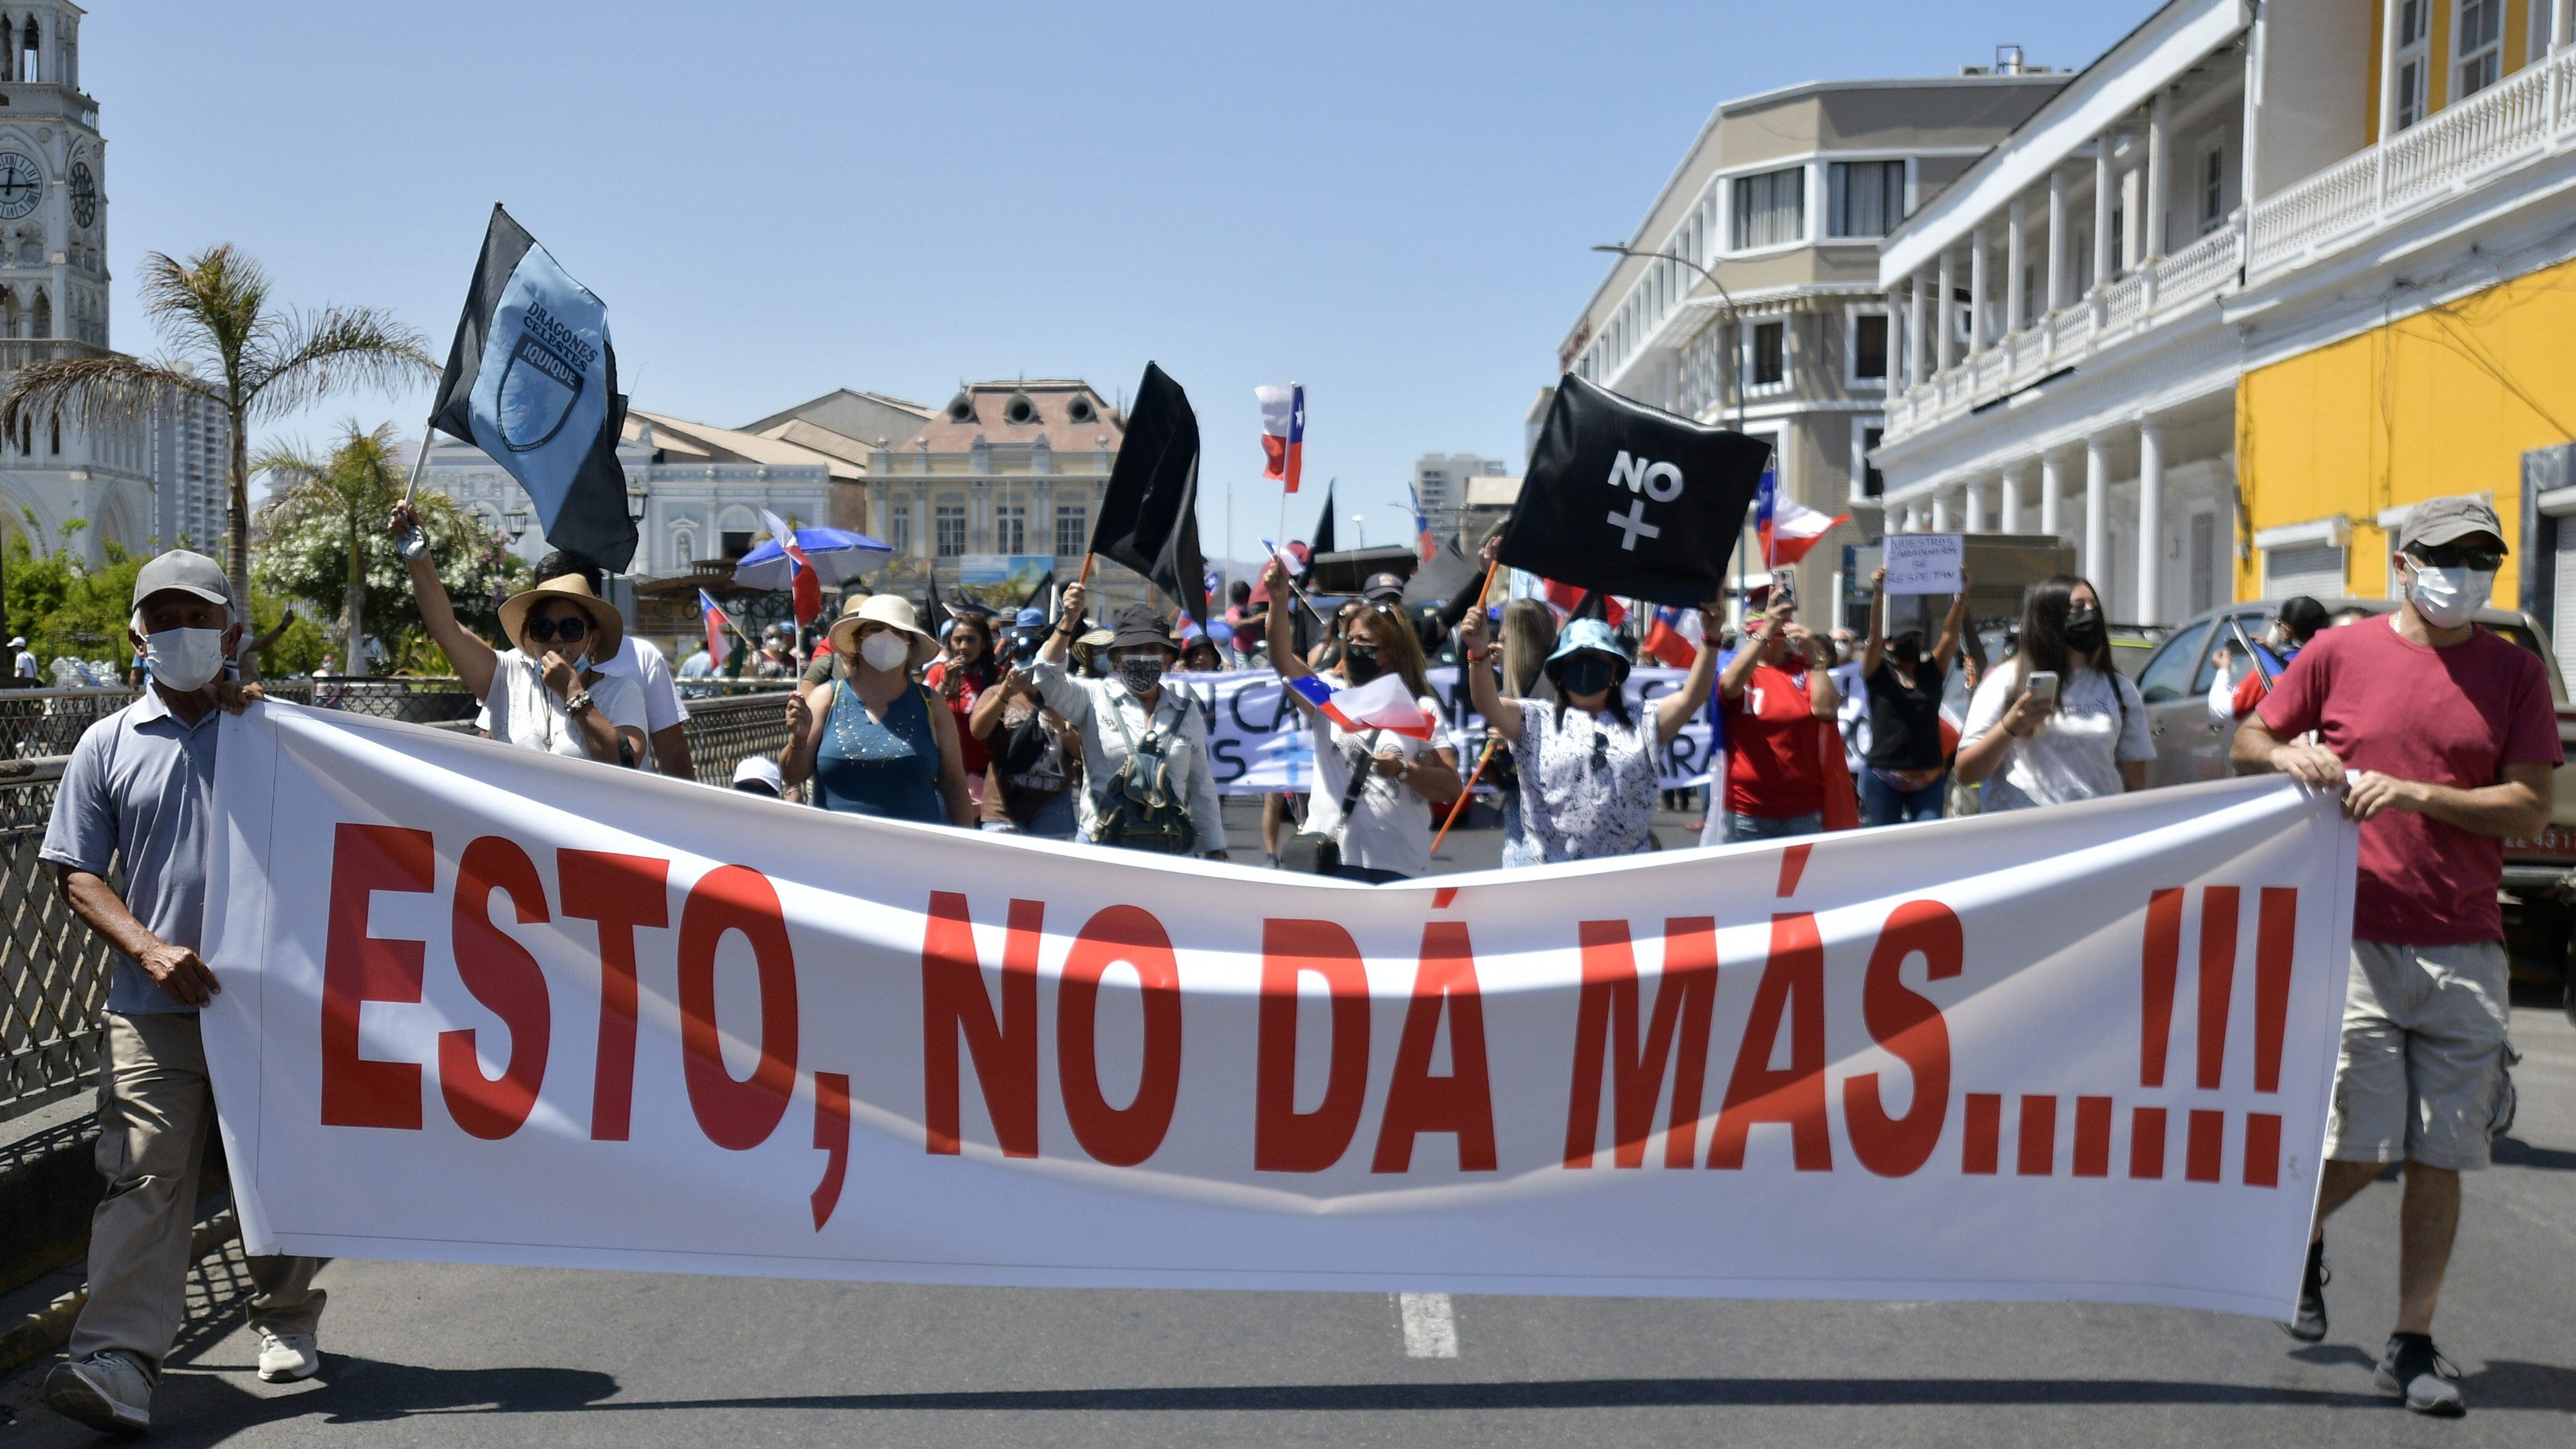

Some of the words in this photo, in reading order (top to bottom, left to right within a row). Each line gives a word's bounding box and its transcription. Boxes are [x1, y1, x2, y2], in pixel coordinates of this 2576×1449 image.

[523, 316, 587, 372] CELESTES
[527, 301, 598, 363] DRAGONES
[522, 342, 576, 386] IQUIQUE
[1608, 450, 1683, 502] NO
[321, 822, 852, 1233] ESTO,
[922, 890, 1182, 1167] NO
[1254, 886, 1497, 1174] DÁ
